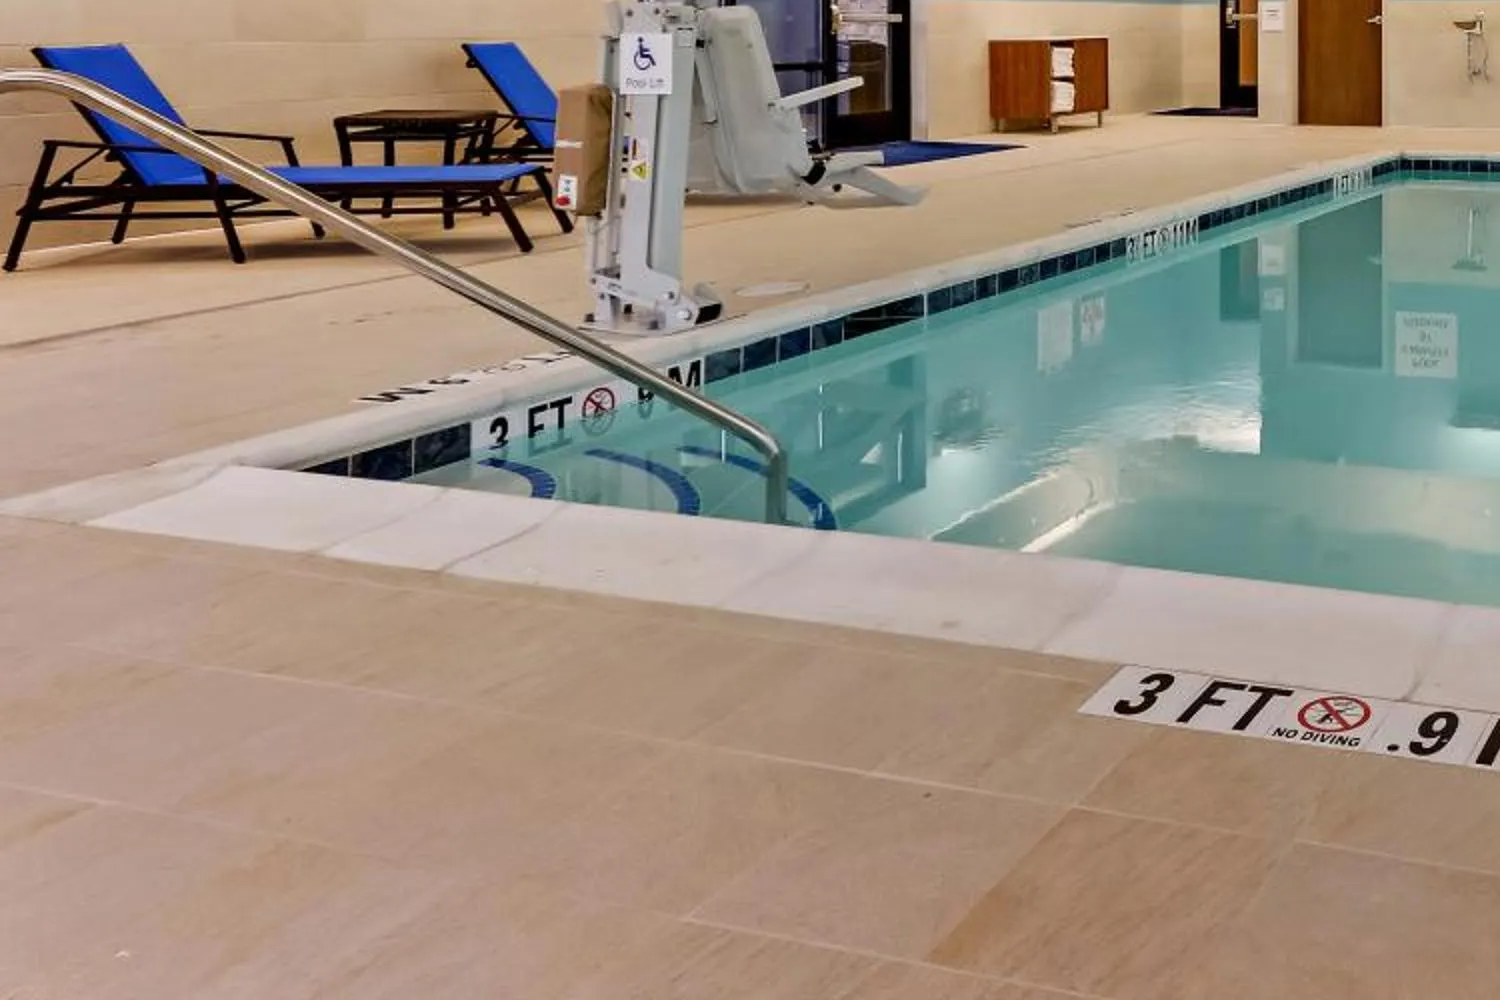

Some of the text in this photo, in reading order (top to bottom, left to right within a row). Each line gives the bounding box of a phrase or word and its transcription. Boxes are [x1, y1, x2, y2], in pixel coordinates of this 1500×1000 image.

[488, 417, 510, 449] 3
[527, 396, 573, 439] FT
[1113, 673, 1175, 715] 3
[1176, 680, 1295, 731] FT
[1272, 727, 1360, 748] NO DIVING
